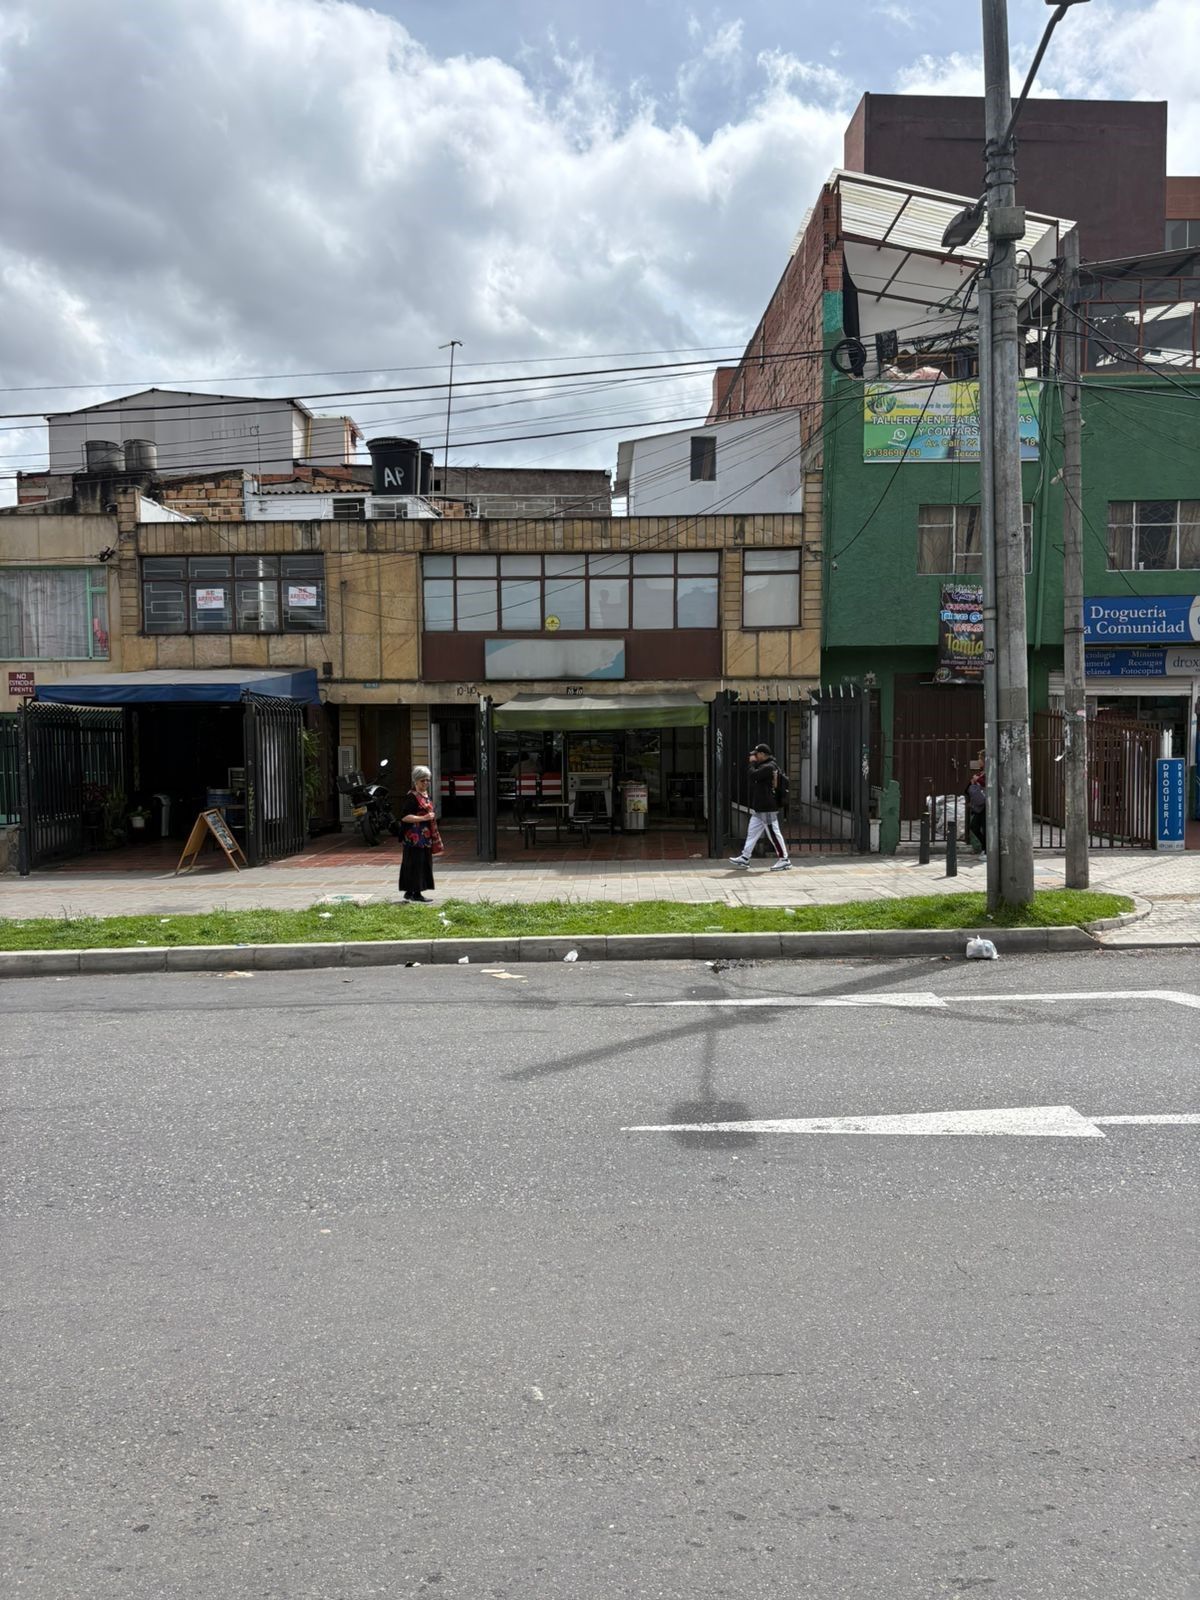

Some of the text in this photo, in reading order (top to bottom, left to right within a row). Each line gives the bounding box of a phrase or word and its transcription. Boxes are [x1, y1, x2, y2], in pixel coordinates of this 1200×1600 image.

[872, 415, 924, 425] TALLERES
[927, 416, 940, 424] EN
[944, 415, 980, 424] TEATR
[927, 427, 980, 436] COMPARS
[384, 467, 404, 487] AP
[1090, 605, 1167, 623] Droguería
[1096, 620, 1185, 634] Comunidad
[1131, 650, 1163, 658] Minutos
[1128, 659, 1163, 667] Recargas
[1121, 667, 1162, 676] Fotocopias
[1162, 763, 1170, 836] DROGUERÍA
